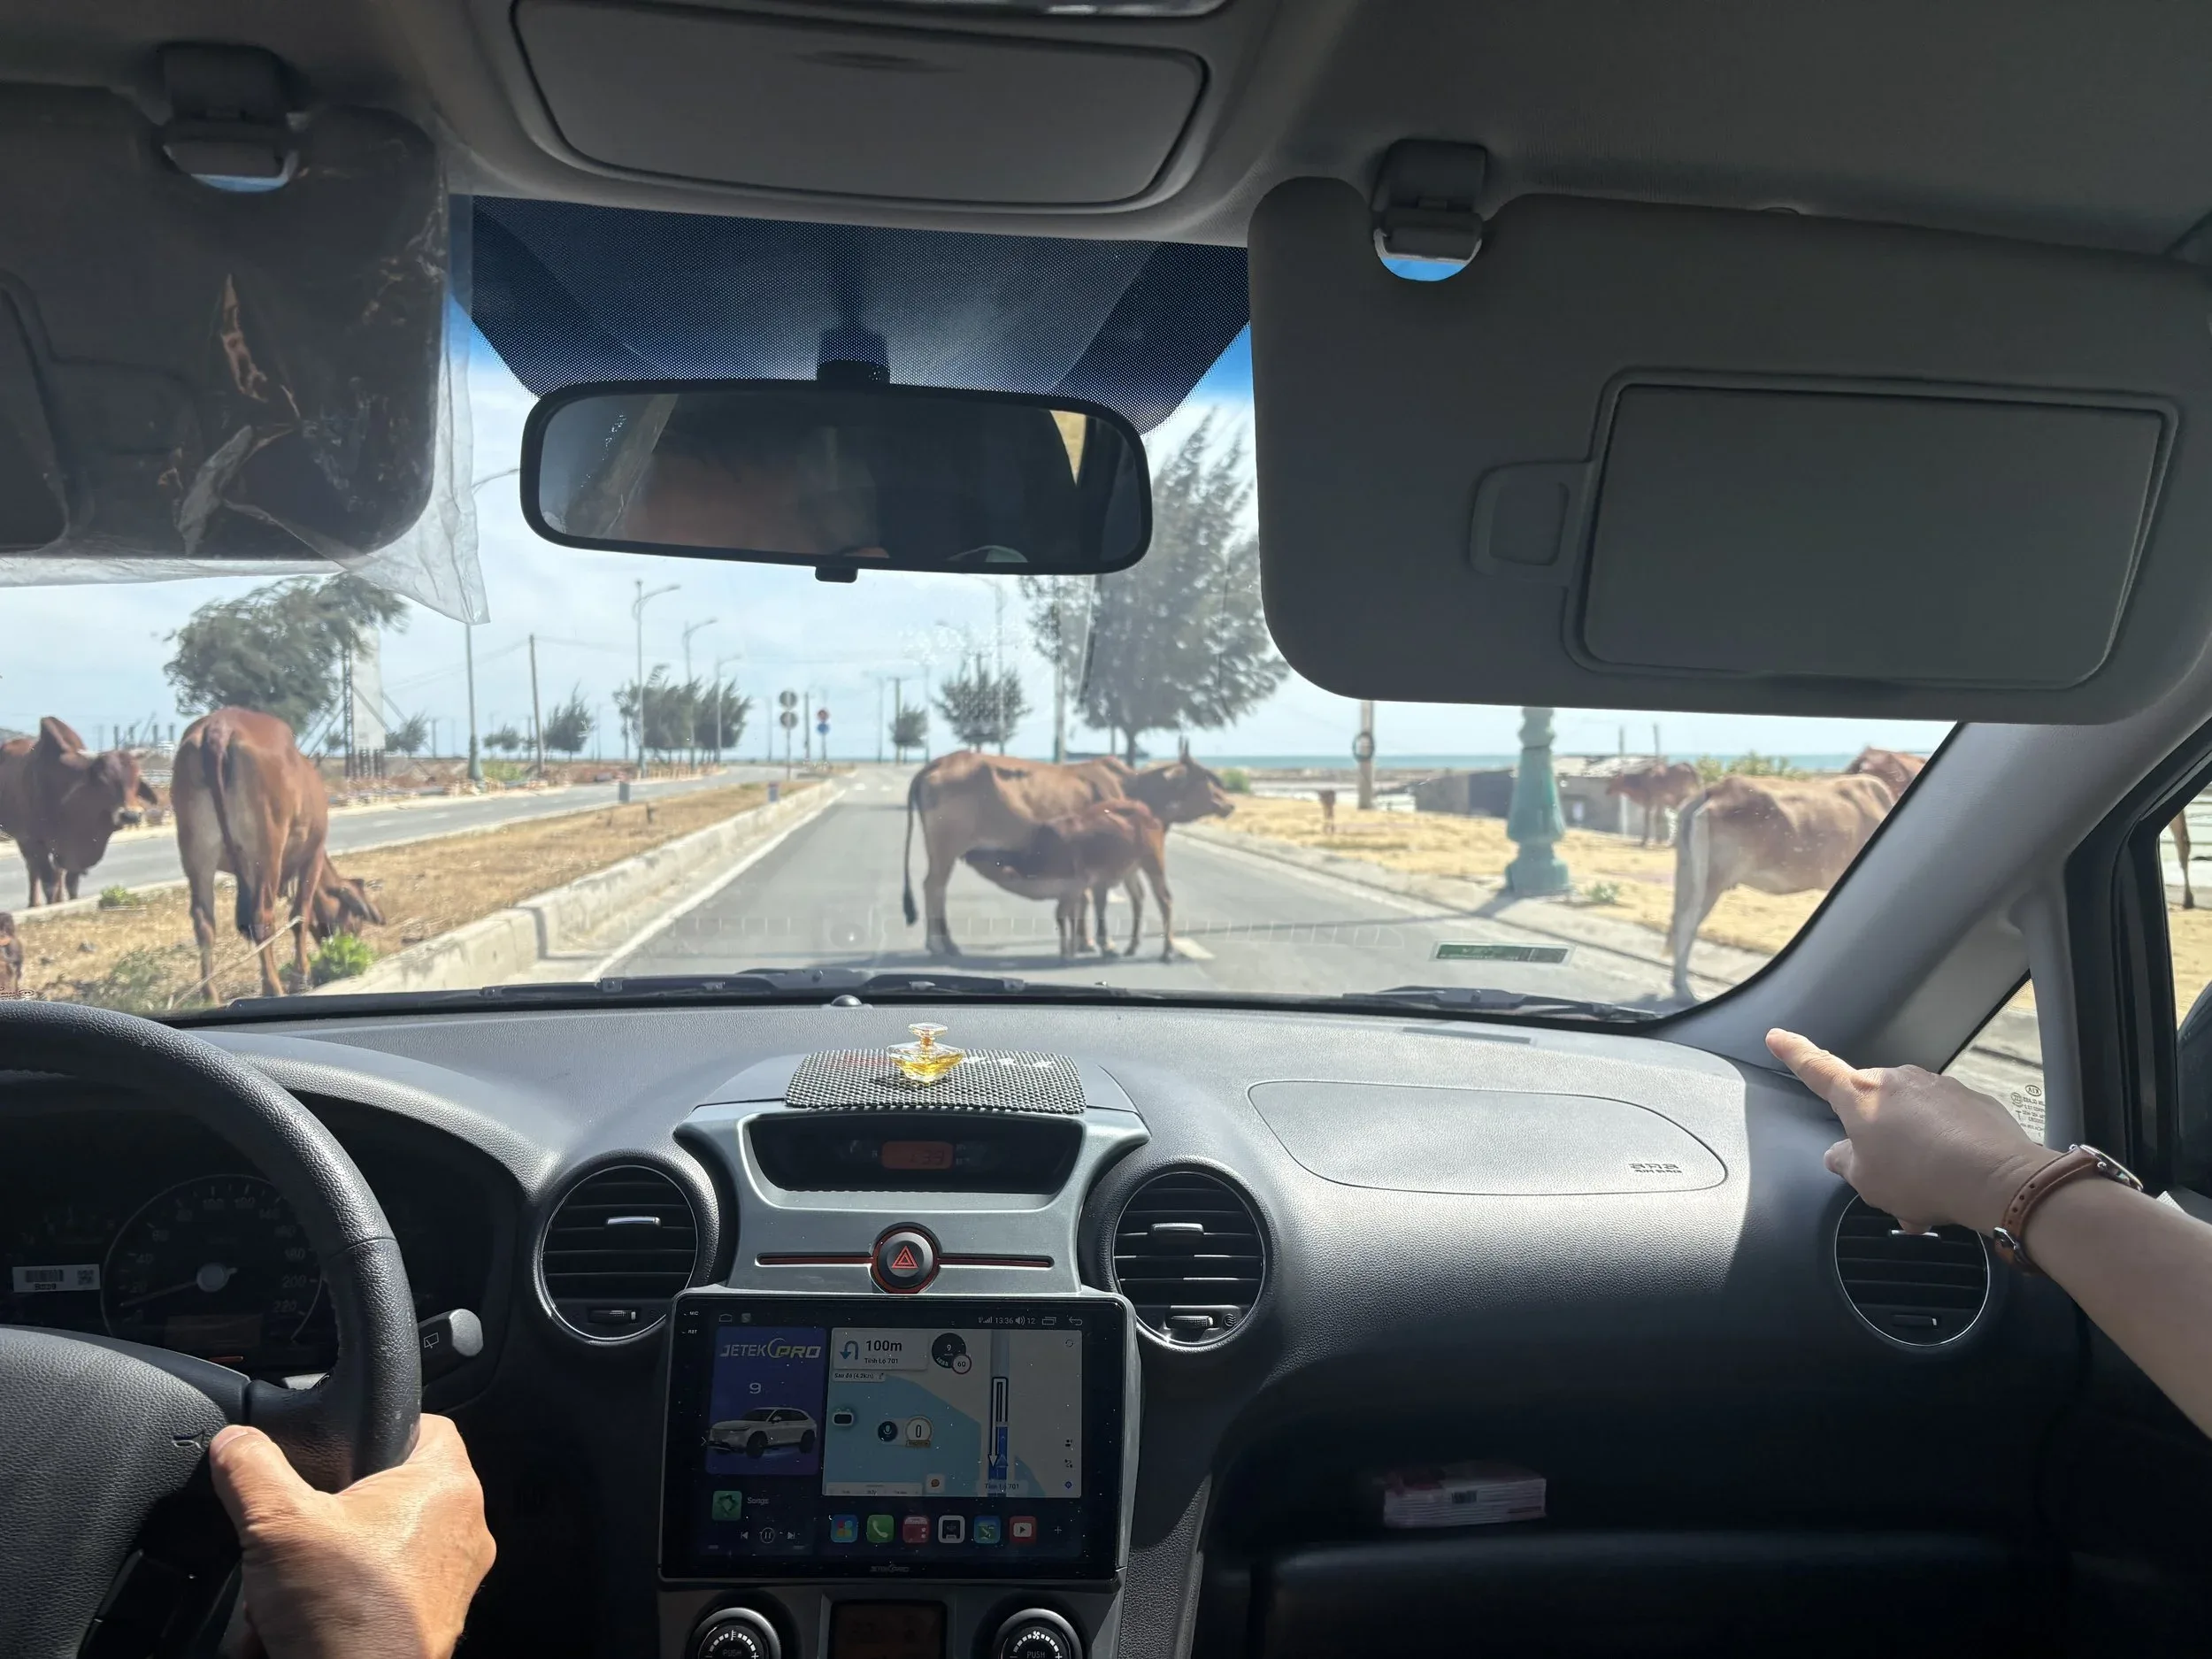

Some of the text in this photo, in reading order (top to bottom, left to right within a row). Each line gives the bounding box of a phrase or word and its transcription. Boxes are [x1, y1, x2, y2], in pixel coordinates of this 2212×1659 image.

[281, 1275, 307, 1288] 200
[272, 1300, 298, 1314] 220
[720, 1344, 767, 1357] JETEK
[865, 1340, 902, 1352] 100m
[749, 1382, 762, 1394] 9
[916, 1425, 922, 1438] 0
[1026, 1650, 1046, 1659] PUSH
